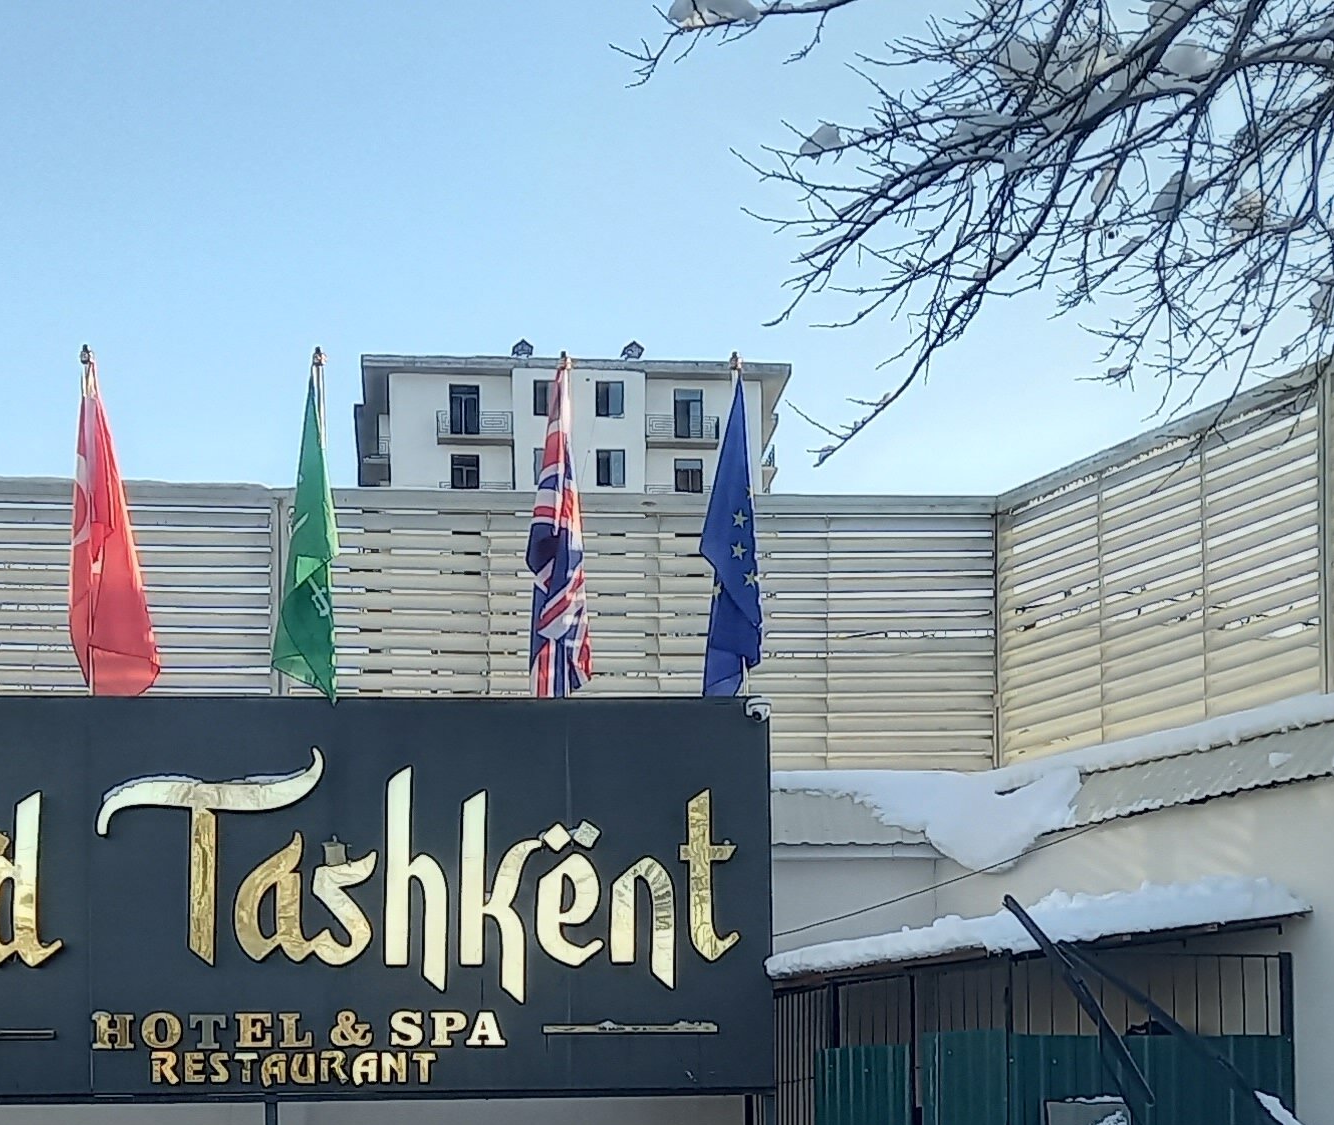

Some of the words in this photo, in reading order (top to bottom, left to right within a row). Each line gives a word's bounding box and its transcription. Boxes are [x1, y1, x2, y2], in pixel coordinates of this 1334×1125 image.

[91, 1011, 313, 1050] HOTEL
[330, 1011, 373, 1048] &
[389, 1010, 506, 1047] SPA
[150, 1051, 438, 1086] RESTAURANT
